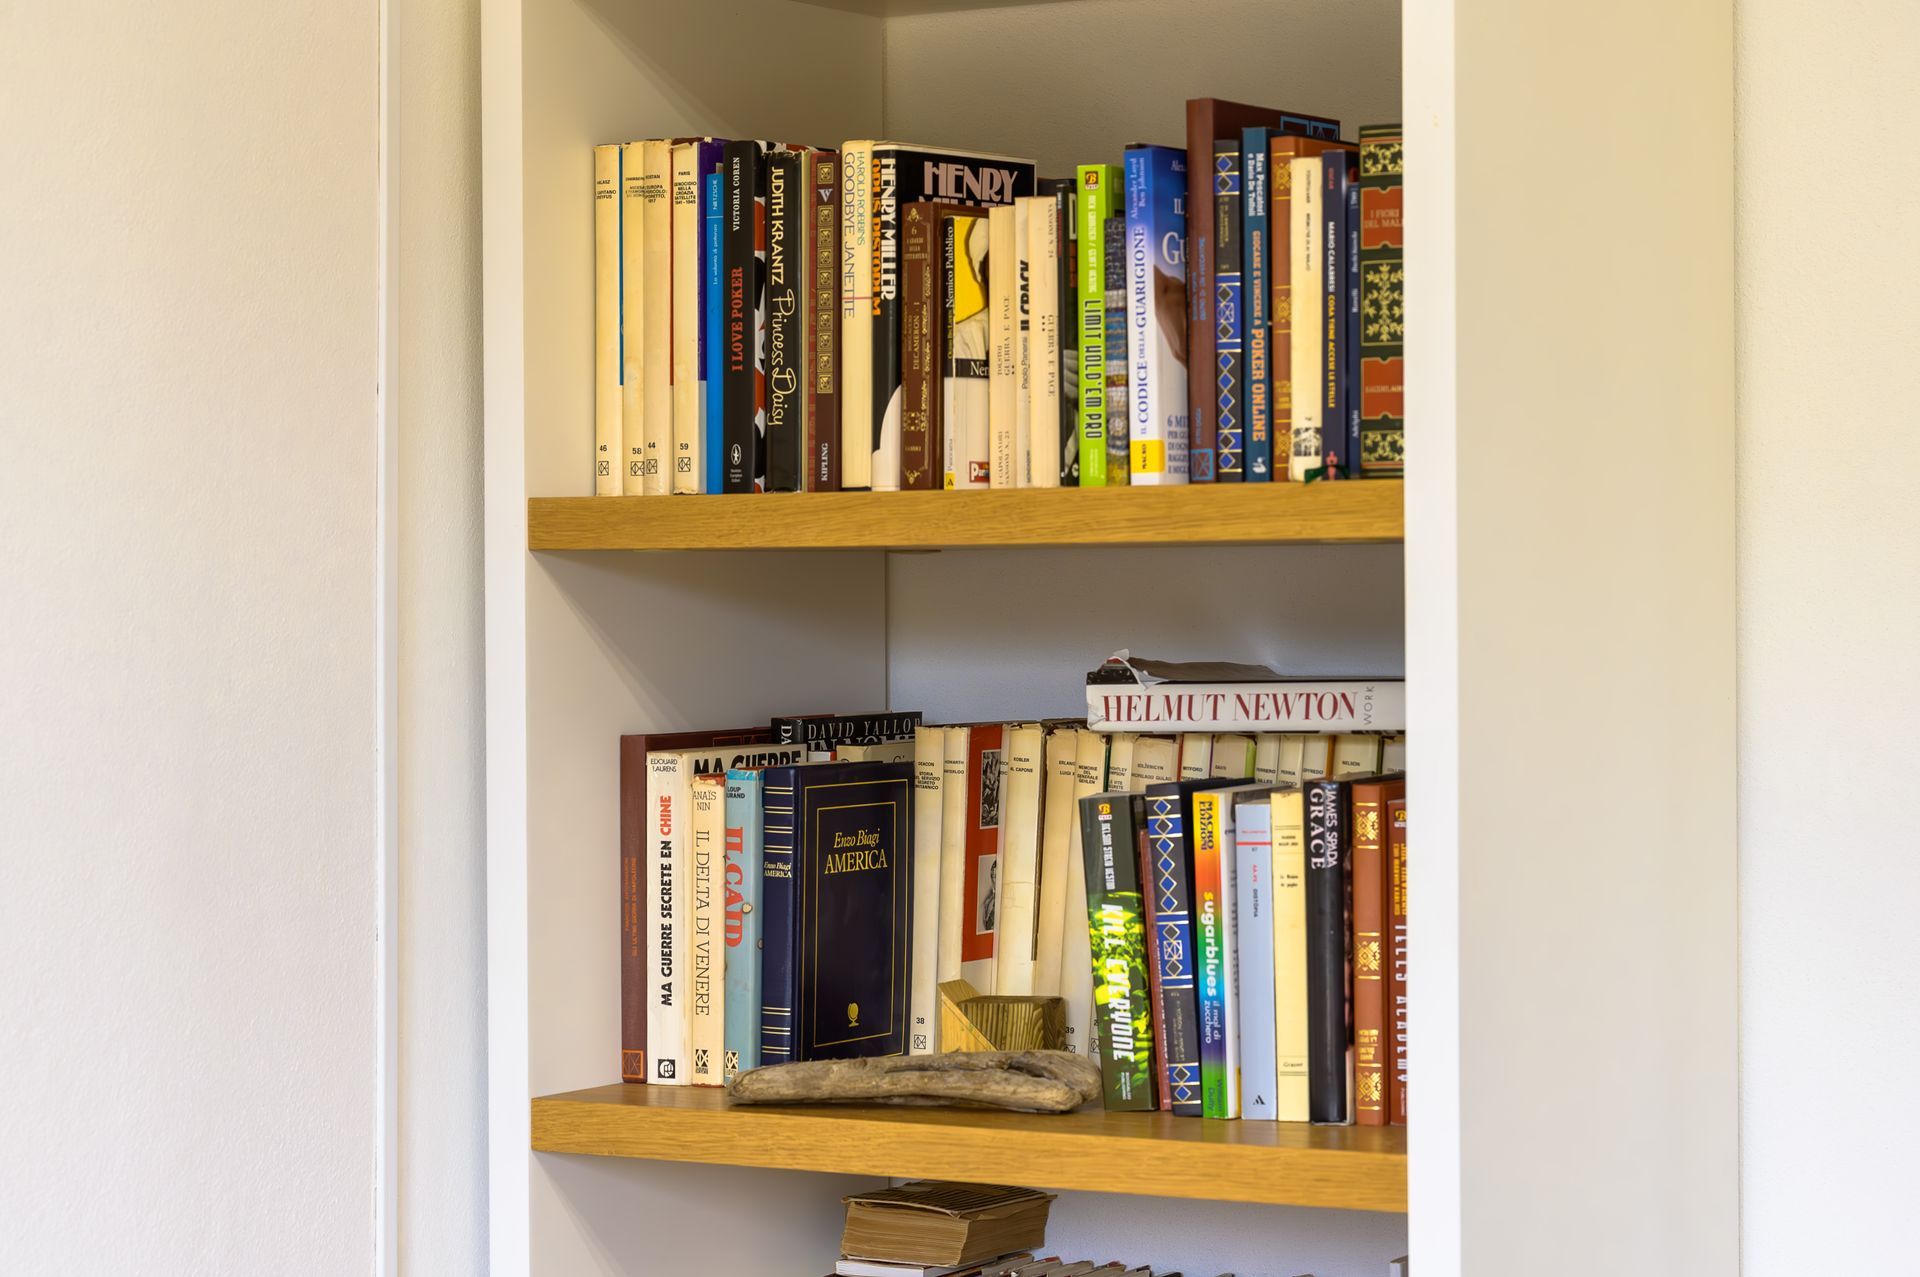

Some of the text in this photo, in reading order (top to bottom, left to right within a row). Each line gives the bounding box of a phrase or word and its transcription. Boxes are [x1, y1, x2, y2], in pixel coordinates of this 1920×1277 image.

[924, 161, 1018, 204] HENRY
[1130, 158, 1138, 178] Loyd
[1248, 180, 1255, 191] De
[1256, 153, 1265, 216] Max Pescatori
[771, 166, 784, 285] JUDITH KRANTZ
[844, 152, 855, 319] GOODBYE JANETTE
[880, 158, 896, 300] HENRY MILLER
[1252, 230, 1262, 269] GIOCARE
[732, 267, 743, 318] POKER
[946, 271, 954, 308] Nemico
[1133, 227, 1146, 328] GUARIGIONE
[1253, 278, 1262, 318] VINCERE
[1084, 300, 1102, 339] LIMIT
[732, 322, 743, 361] LOVE
[767, 288, 796, 425] Princess Daisy
[1252, 328, 1265, 380] POKER
[1084, 345, 1102, 407] HOLD'EM
[1137, 361, 1148, 424] CODICE
[1328, 372, 1336, 380] LE
[1084, 413, 1102, 438] PRO
[1140, 427, 1147, 435] IL
[1252, 384, 1266, 441] ONLINE
[1101, 686, 1375, 725] HELMUT NEWTON WORK
[808, 722, 854, 739] DAVID
[694, 758, 724, 774] MA
[692, 790, 716, 800] ANAÏS
[697, 802, 710, 811] NIN
[725, 827, 743, 861] IL
[834, 828, 880, 848] Enzo Biagi
[1310, 788, 1324, 870] GRACE
[1326, 789, 1337, 868] JAMES SPADA
[776, 862, 792, 870] Biagi
[824, 849, 888, 874] AMERICA
[660, 796, 672, 1006] MA GUERRE SECRETE EN CHINE
[696, 830, 709, 1016] IL DELTA DI VENERE
[1201, 892, 1219, 996] sugarblues
[1102, 904, 1134, 1062] KILL EVERYONE
[1204, 1000, 1213, 1043] zucchero
[1214, 1030, 1221, 1040] di
